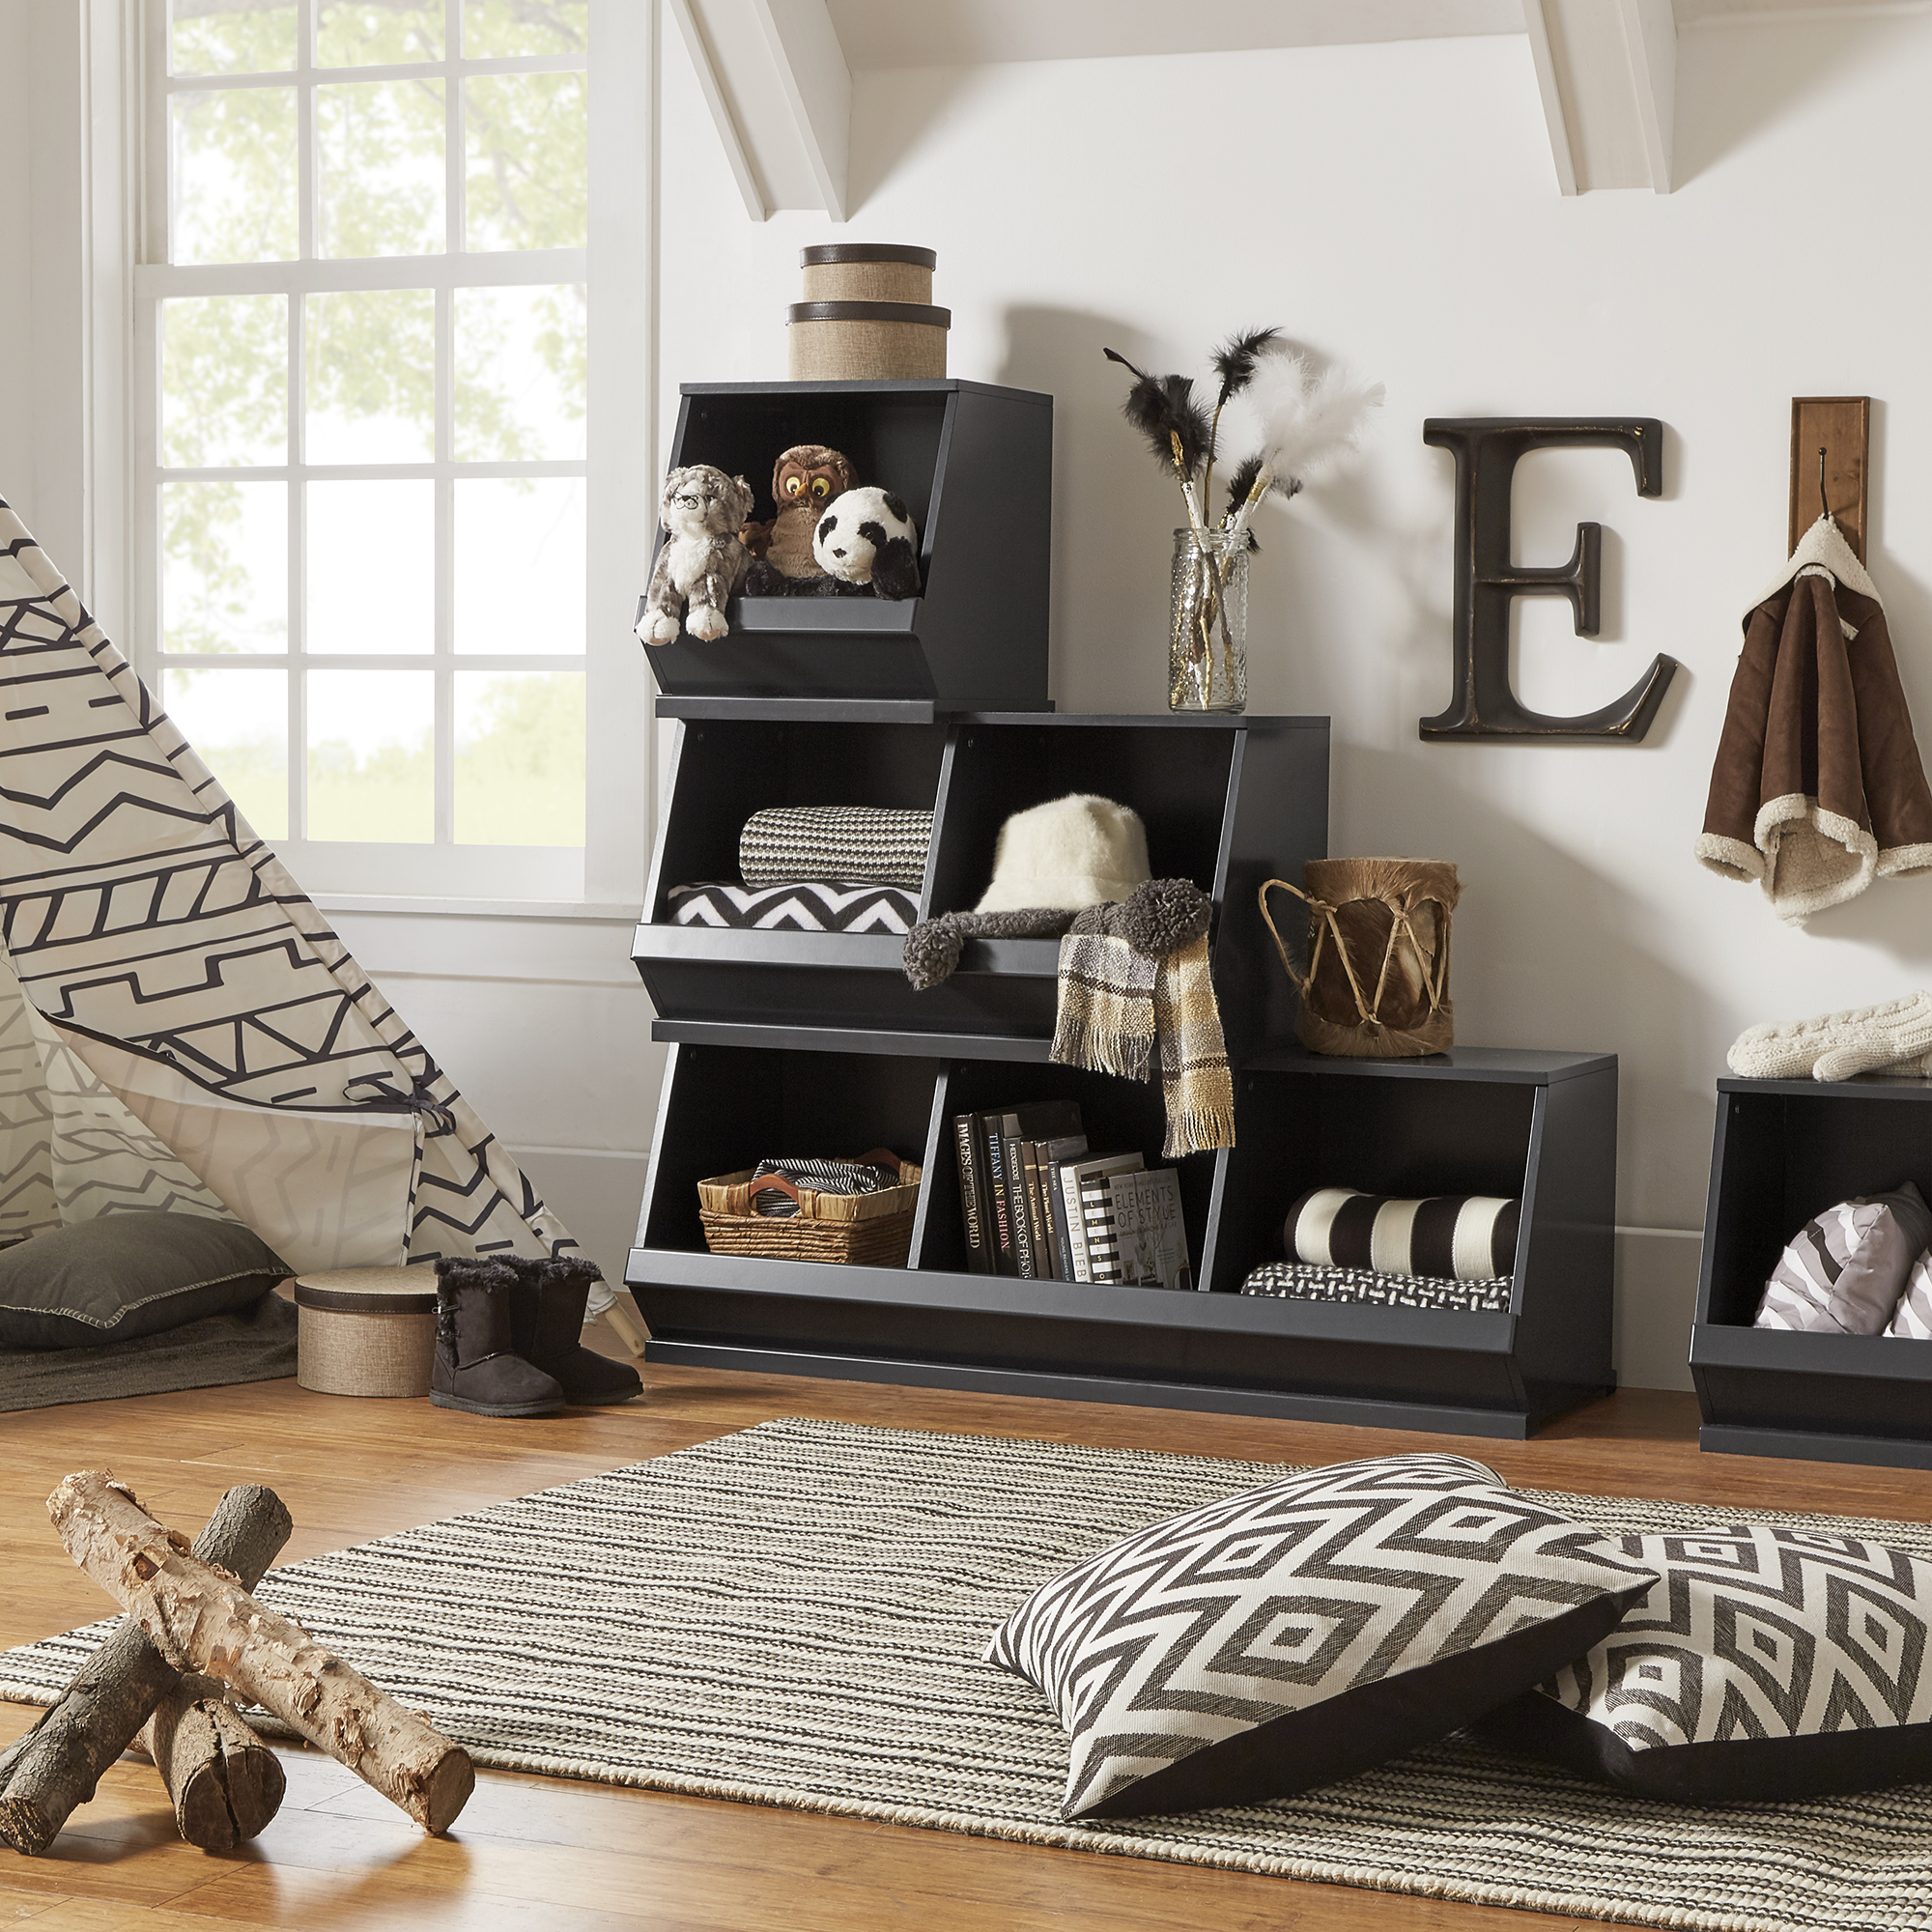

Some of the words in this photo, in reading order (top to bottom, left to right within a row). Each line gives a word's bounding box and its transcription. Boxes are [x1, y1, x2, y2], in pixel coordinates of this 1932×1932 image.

[1419, 417, 1678, 744] E
[957, 1122, 972, 1166] IMAGES
[989, 1132, 1003, 1179] TIFFANY
[962, 1165, 974, 1181] OF
[994, 1183, 1005, 1196] IN
[1012, 1183, 1024, 1204] THE
[1115, 1186, 1174, 1210] ELEMENTS
[1014, 1205, 1027, 1234] BOOK
[1030, 1196, 1038, 1221] Animal
[1118, 1209, 1133, 1228] OF
[1138, 1204, 1176, 1225] STYLE
[967, 1208, 980, 1249] WORLD
[996, 1200, 1010, 1252] FASHION
[1033, 1221, 1041, 1241] World
[1045, 1214, 1054, 1234] World
[1064, 1177, 1081, 1233] JUSTIN
[1073, 1242, 1087, 1281] BIEB
[1017, 1234, 1029, 1248] OF
